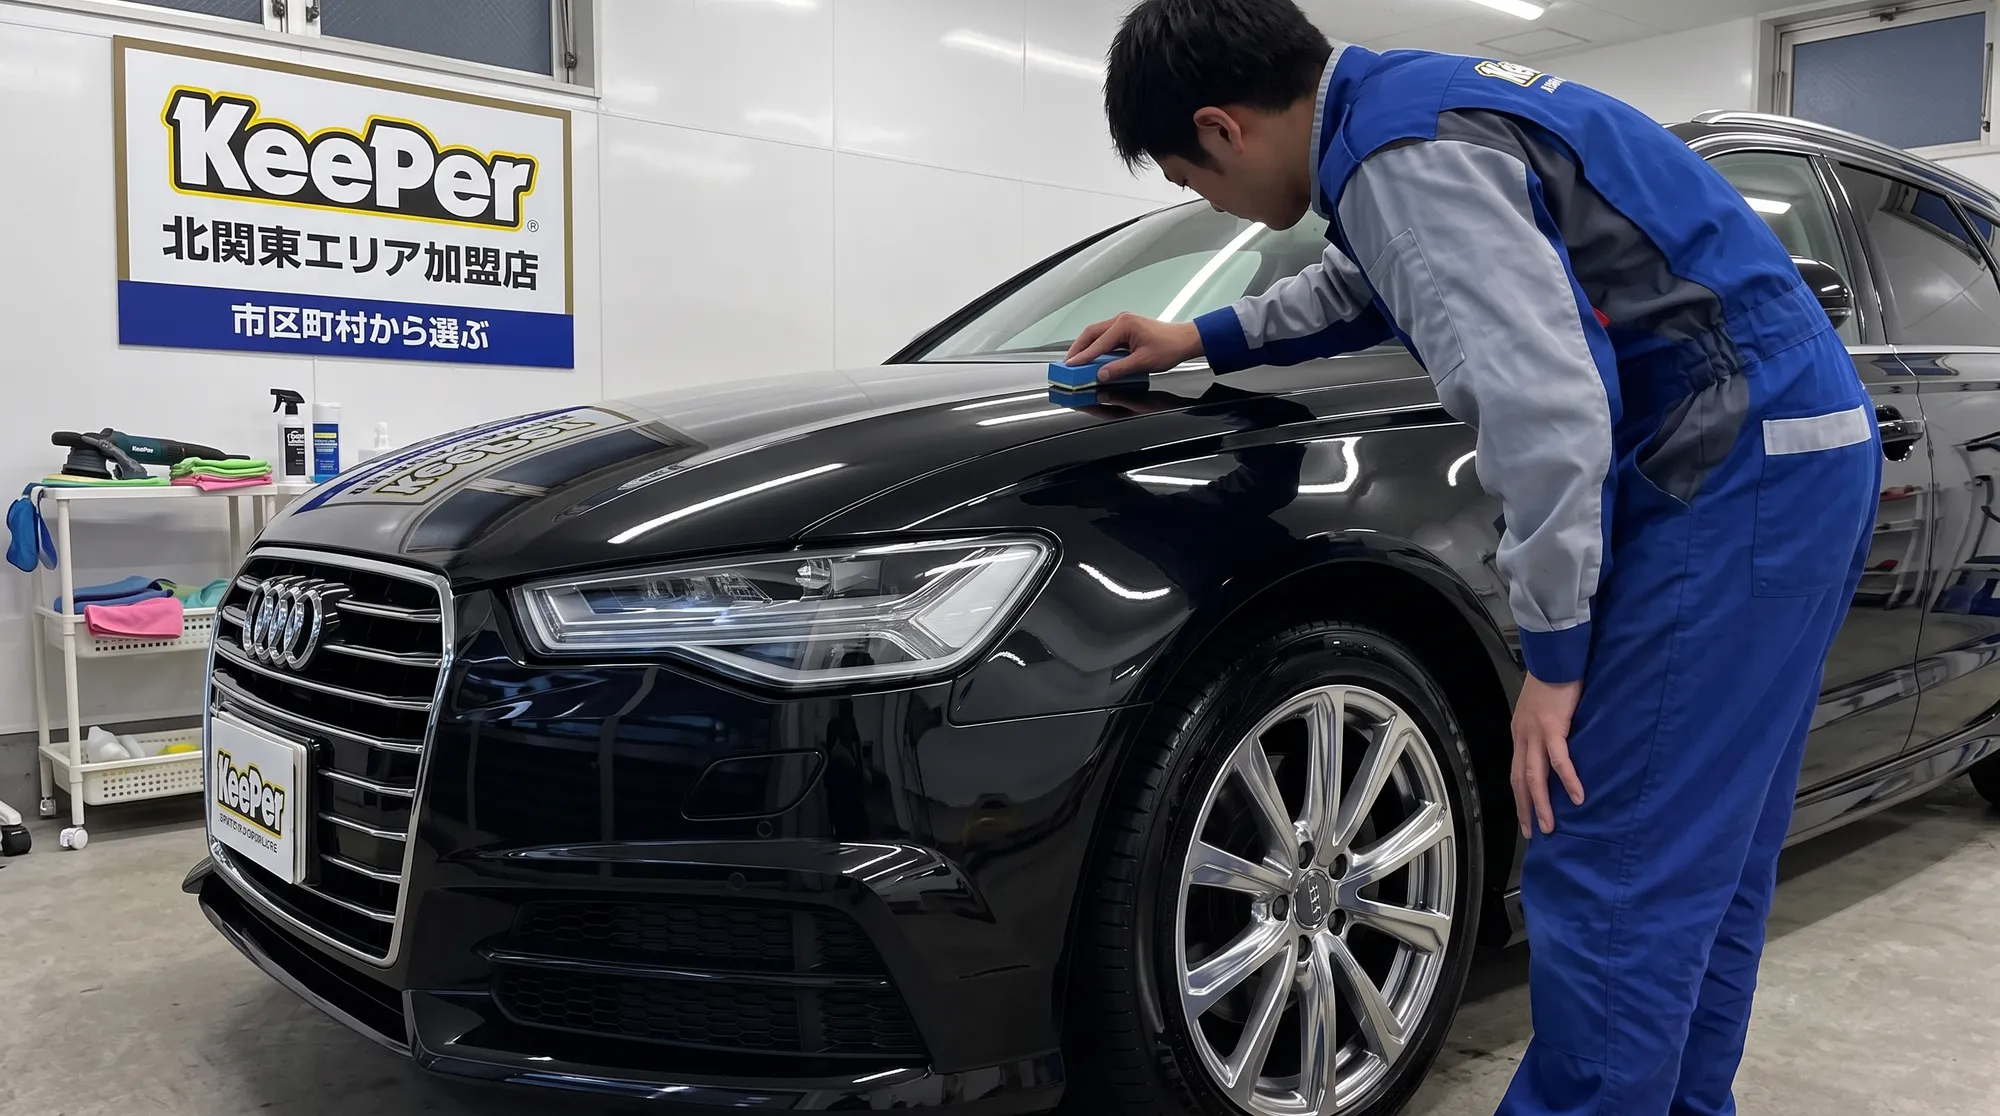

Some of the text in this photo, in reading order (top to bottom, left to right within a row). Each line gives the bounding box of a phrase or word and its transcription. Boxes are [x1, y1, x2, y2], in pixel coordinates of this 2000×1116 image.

[164, 89, 537, 229] KeePer
[162, 215, 539, 291] 北関東エリア加盟店
[231, 302, 490, 350] 市区町村から選ぶ
[217, 751, 285, 837] KeePer
